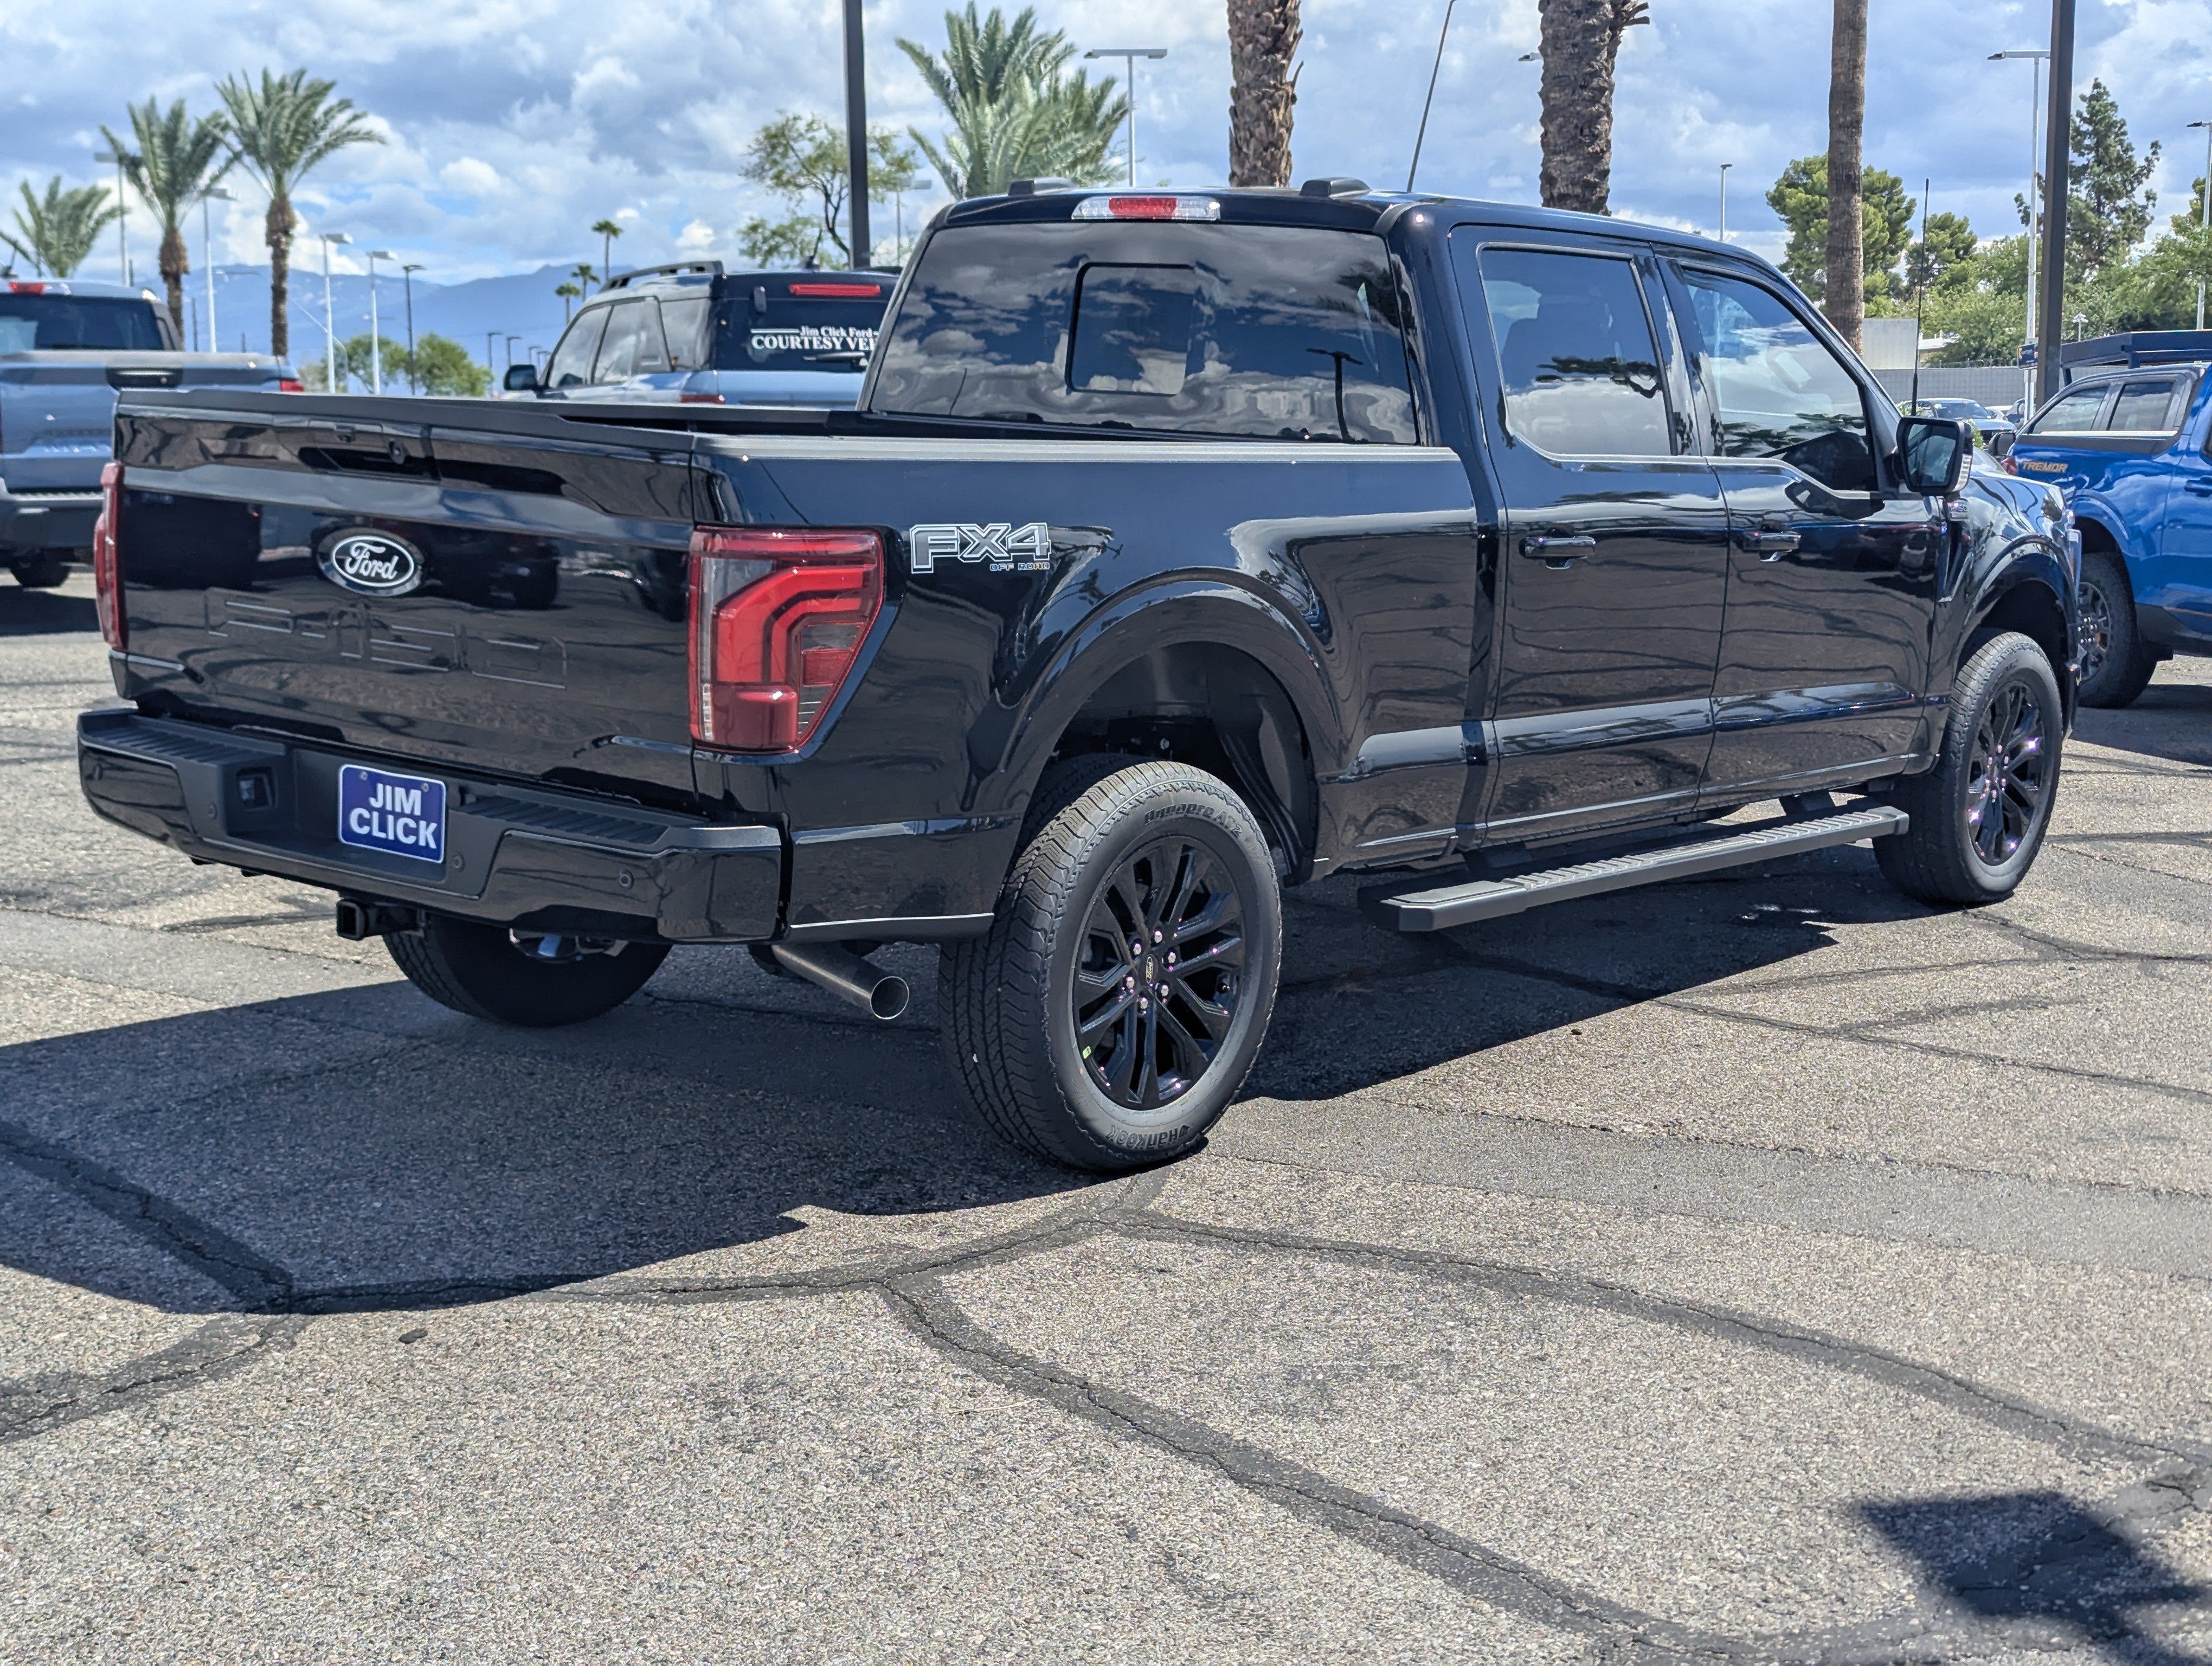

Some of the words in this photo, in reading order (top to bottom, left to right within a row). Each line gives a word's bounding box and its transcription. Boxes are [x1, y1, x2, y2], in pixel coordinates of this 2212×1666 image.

[751, 335, 843, 350] COURTESY
[800, 325, 819, 336] Jim
[820, 326, 847, 337] Click
[848, 327, 872, 337] Ford
[2022, 461, 2068, 473] TREMOR
[345, 542, 399, 580] Ford
[910, 523, 1051, 574] FX4
[368, 783, 422, 816] JIM
[350, 808, 438, 849] CLICK
